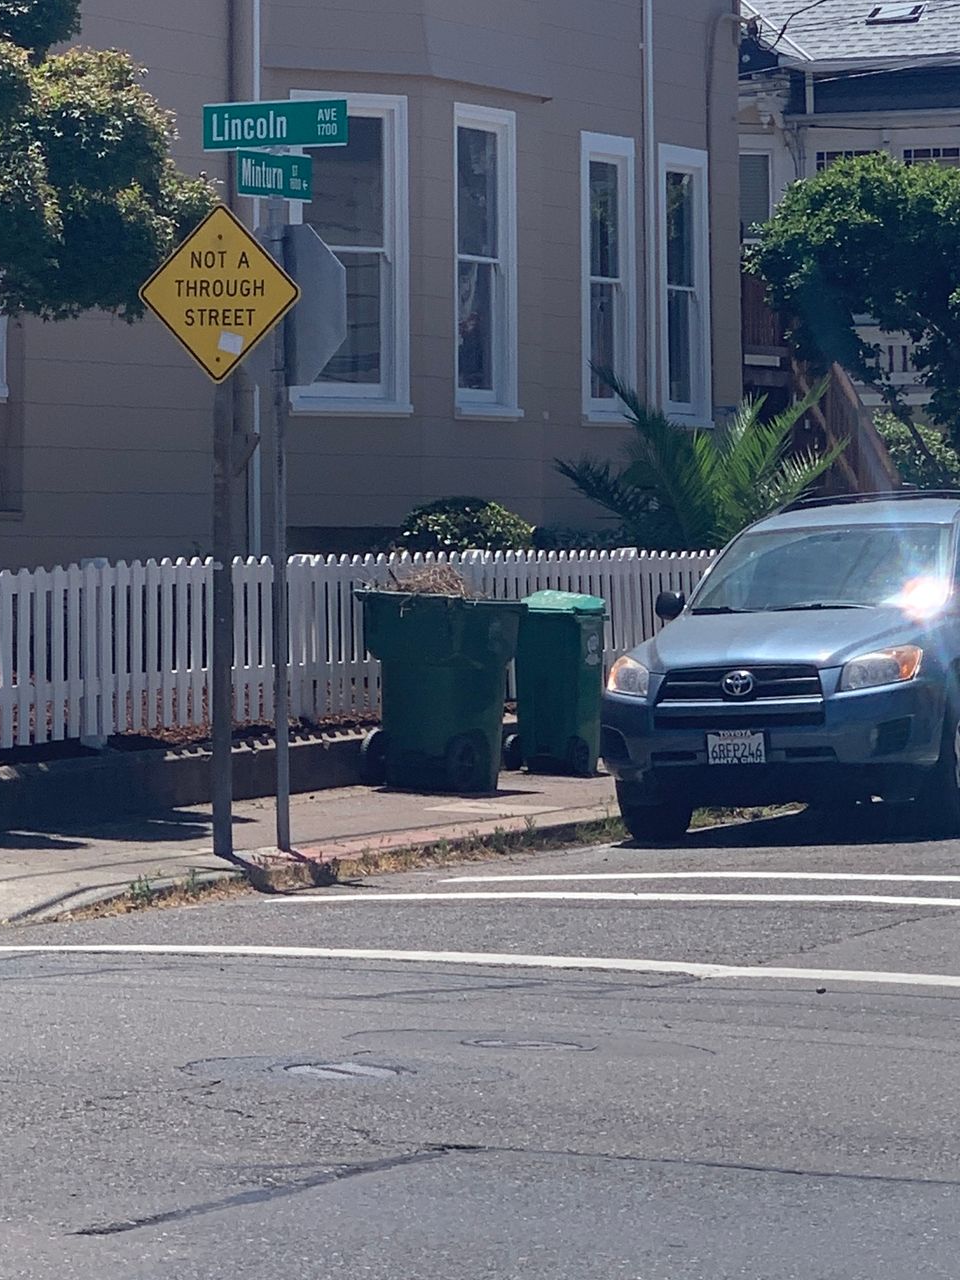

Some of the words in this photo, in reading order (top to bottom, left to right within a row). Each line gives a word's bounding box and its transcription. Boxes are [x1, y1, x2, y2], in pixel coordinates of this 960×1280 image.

[212, 110, 287, 141] Lincoln
[317, 108, 337, 121] AVE
[317, 123, 338, 136] 1700
[241, 157, 283, 190] Minturn
[190, 250, 227, 269] NOT
[237, 250, 250, 269] A
[174, 279, 265, 297] THROUGH
[184, 308, 256, 326] STREET
